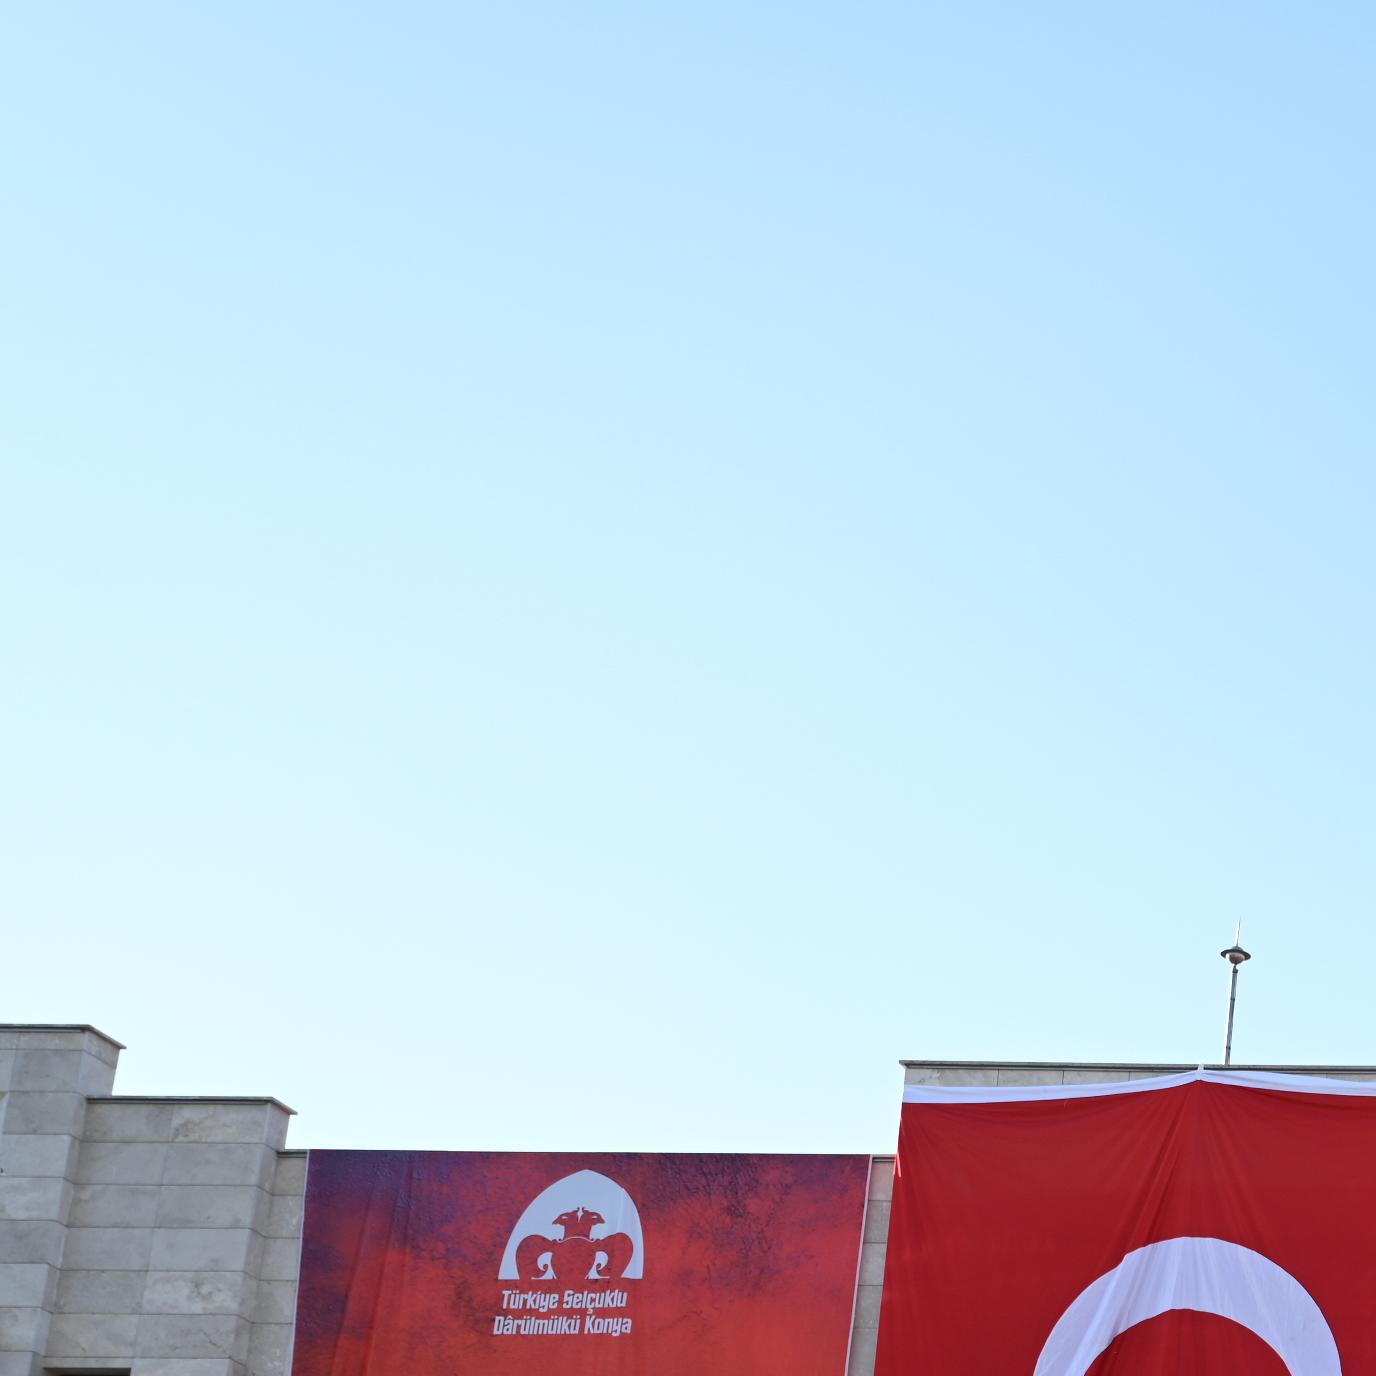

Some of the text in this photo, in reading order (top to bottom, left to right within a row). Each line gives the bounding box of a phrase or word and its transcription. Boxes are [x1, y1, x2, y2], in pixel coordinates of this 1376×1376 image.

[501, 1289, 628, 1314] Türkiye Selçuklu
[493, 1315, 632, 1336] Dârülmülkü Konya
